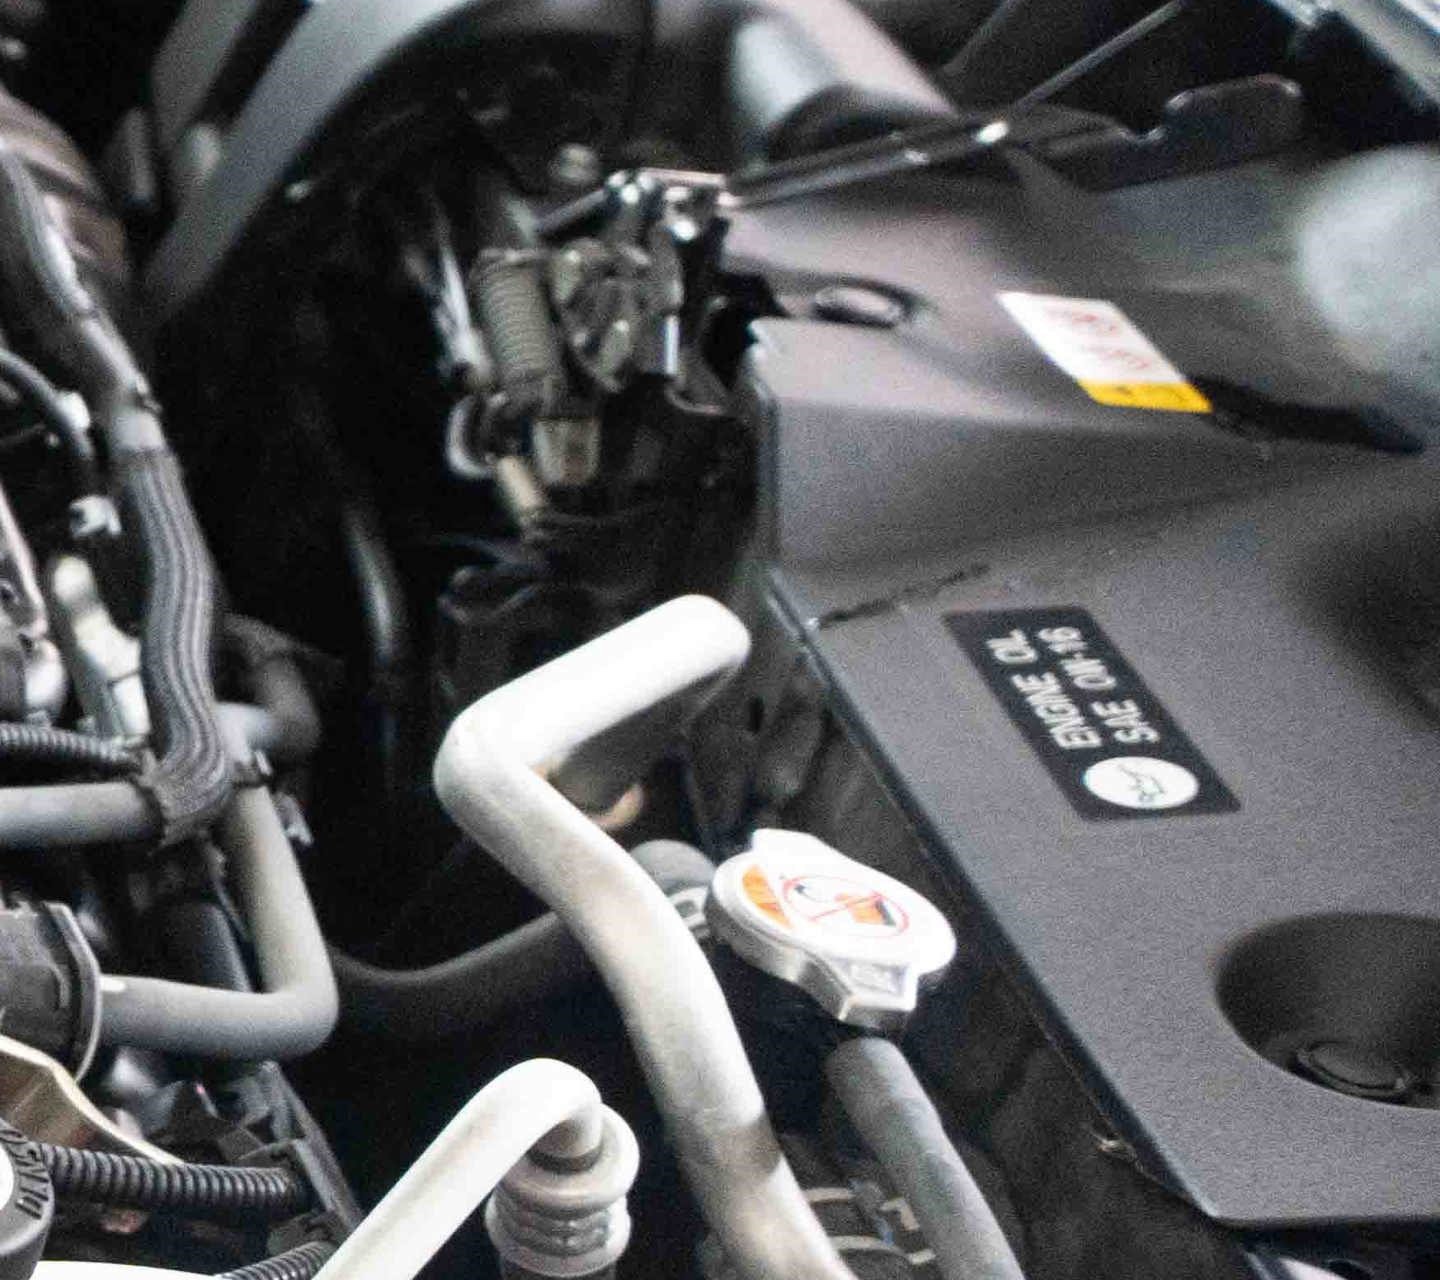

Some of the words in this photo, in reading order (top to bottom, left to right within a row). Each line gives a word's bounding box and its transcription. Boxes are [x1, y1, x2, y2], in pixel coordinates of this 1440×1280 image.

[986, 628, 1039, 664] OIL
[1012, 671, 1103, 749] ENGINE
[1092, 699, 1161, 744] SAE
